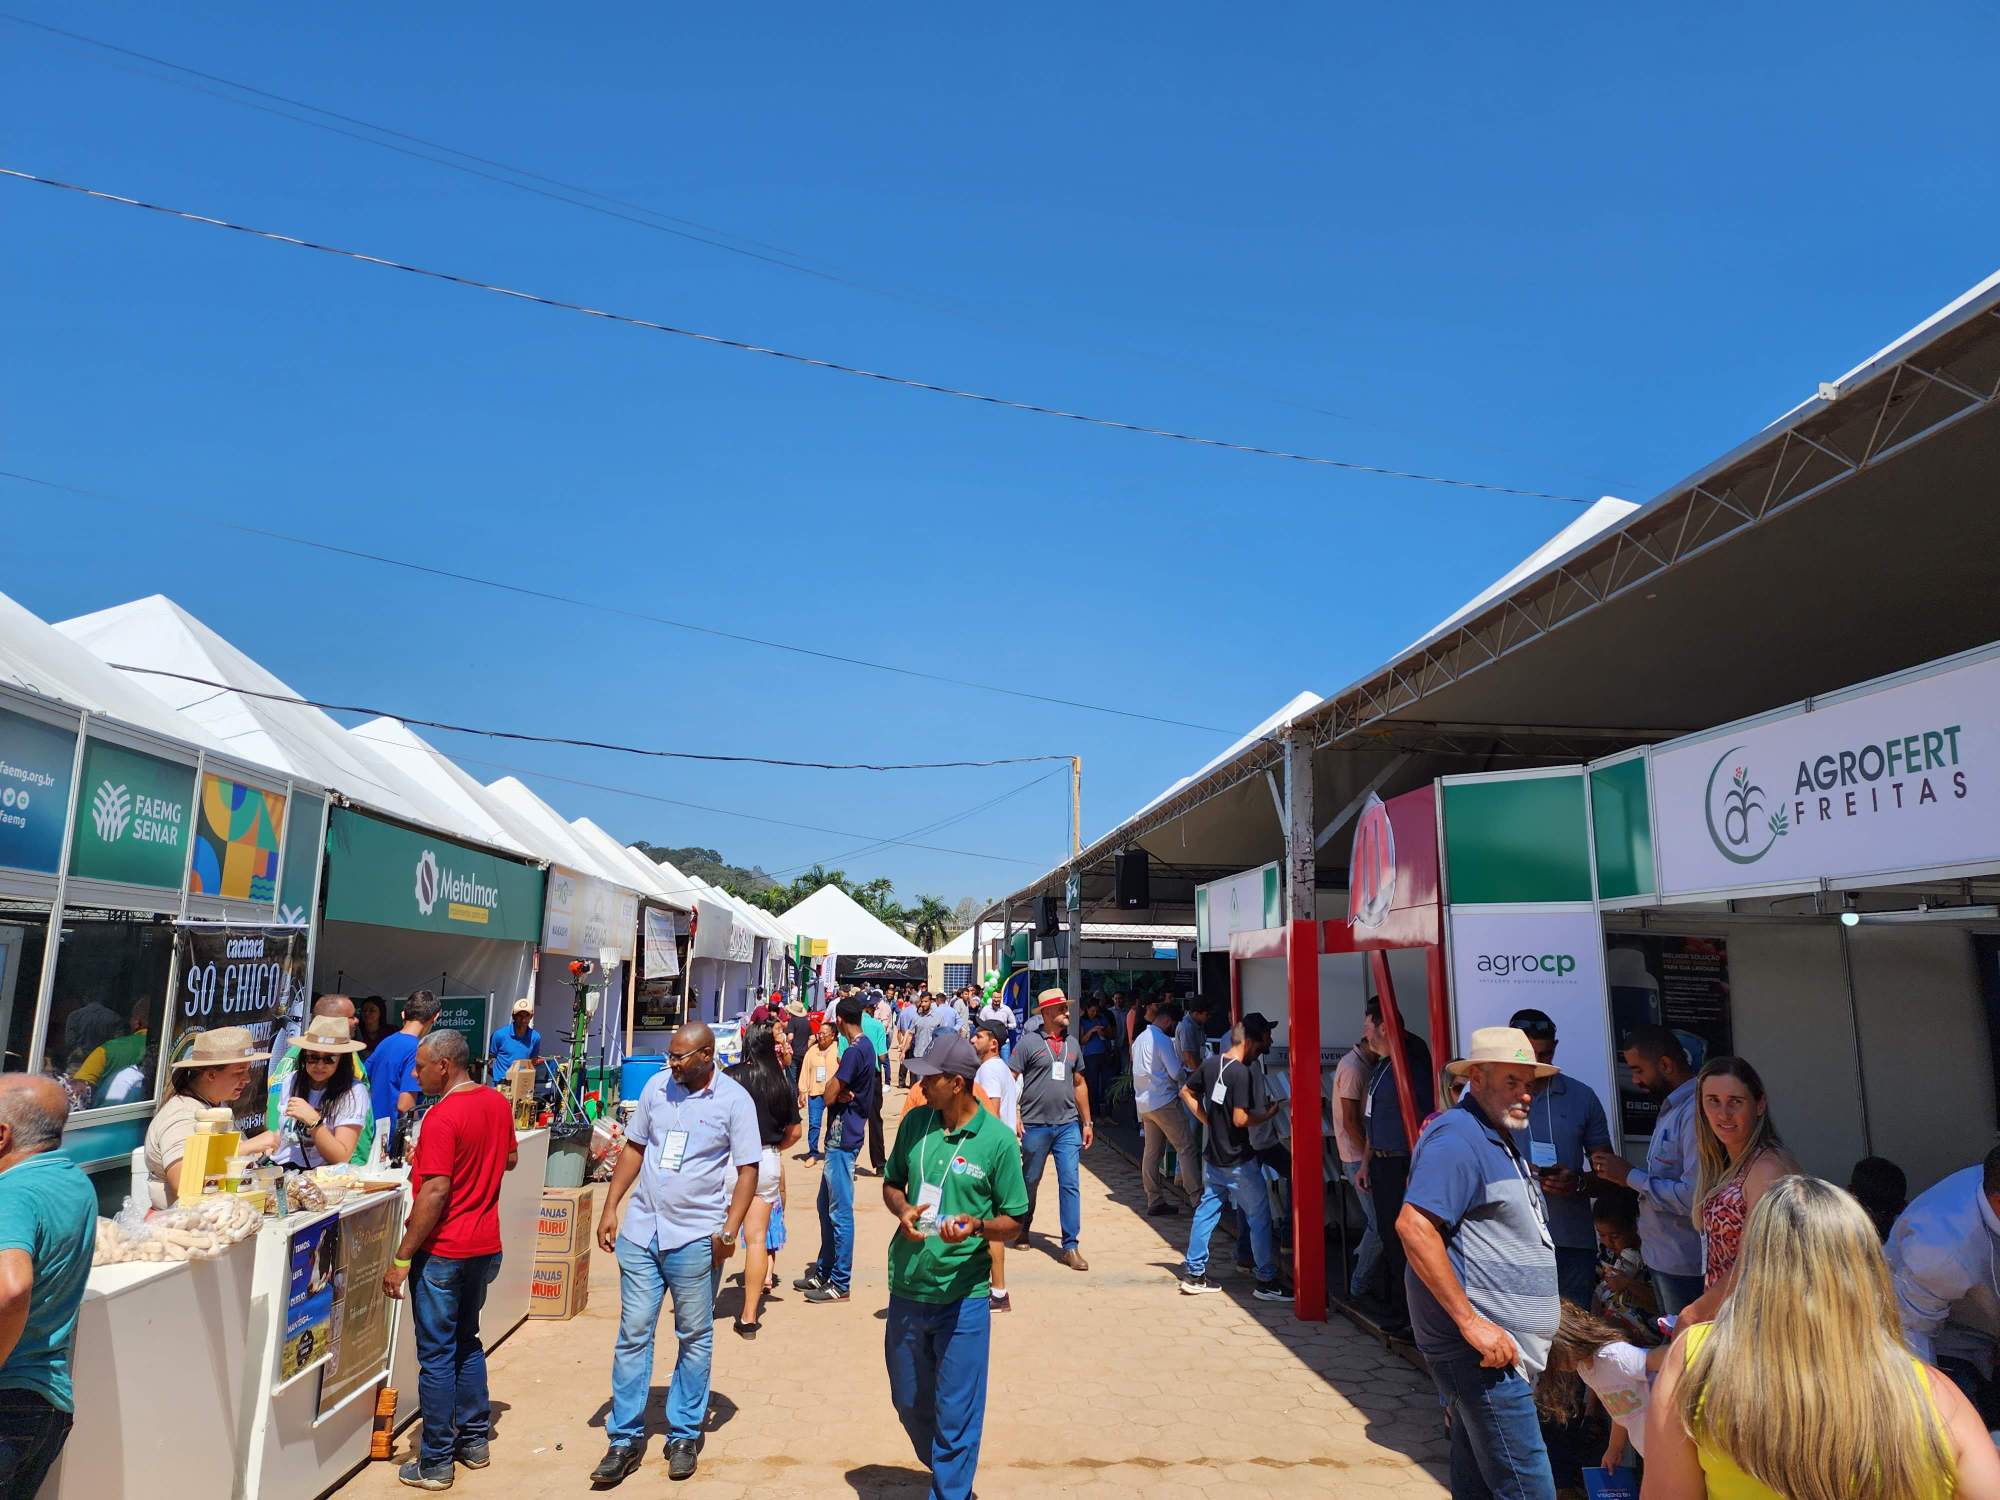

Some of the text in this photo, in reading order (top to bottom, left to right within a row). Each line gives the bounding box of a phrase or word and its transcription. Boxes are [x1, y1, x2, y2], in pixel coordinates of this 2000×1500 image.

[1794, 725, 1962, 796] AGROFERT
[135, 794, 182, 824] FAEMG
[1794, 771, 1968, 825] FREITAS
[132, 817, 178, 846] SENAR
[439, 866, 498, 909] Metalmac
[226, 936, 265, 961] cachaça
[883, 958, 910, 971] Tavola
[1477, 954, 1576, 977] agrocp
[222, 962, 280, 1014] CHICO
[455, 1007, 470, 1017] de
